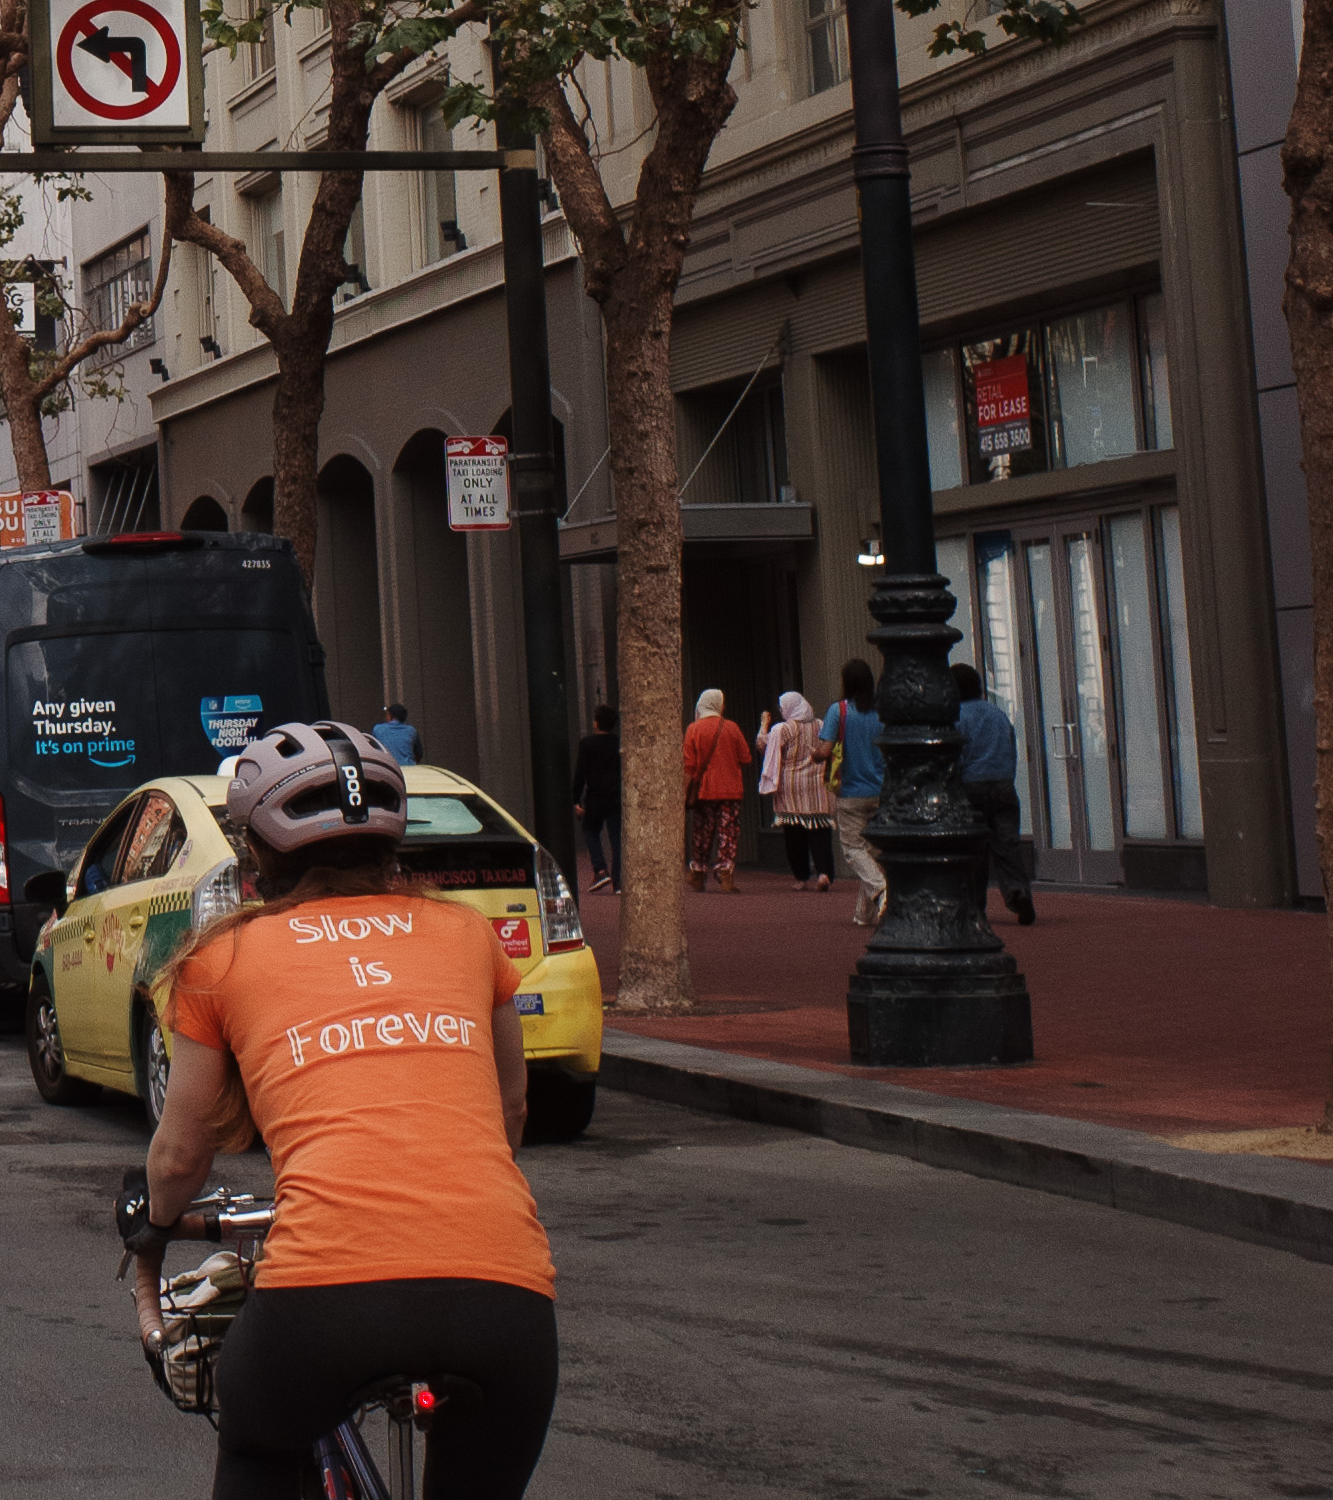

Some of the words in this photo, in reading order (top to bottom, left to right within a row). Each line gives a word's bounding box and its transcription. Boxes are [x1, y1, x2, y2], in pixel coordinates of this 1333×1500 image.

[977, 383, 1003, 402] RETAIL
[978, 403, 997, 422] FOR
[998, 396, 1027, 418] LEASE
[471, 468, 503, 476] LOADING
[463, 478, 493, 488] ONLY
[461, 494, 473, 504] AT
[479, 494, 498, 504] ALL
[464, 506, 495, 517] TIMES
[34, 518, 51, 527] ONLY
[33, 700, 65, 718] Any
[69, 698, 115, 718] given
[33, 718, 116, 736] Thursday.
[209, 718, 258, 730] THURSDAY
[219, 728, 249, 738] NIGHT
[35, 740, 60, 754] It's
[63, 741, 83, 754] on
[87, 737, 135, 756] prime
[411, 870, 477, 885] FRANCISCO
[481, 868, 526, 882] TAXICAB
[289, 912, 413, 944] Slow
[349, 956, 392, 987] is
[287, 1012, 476, 1067] Forever
